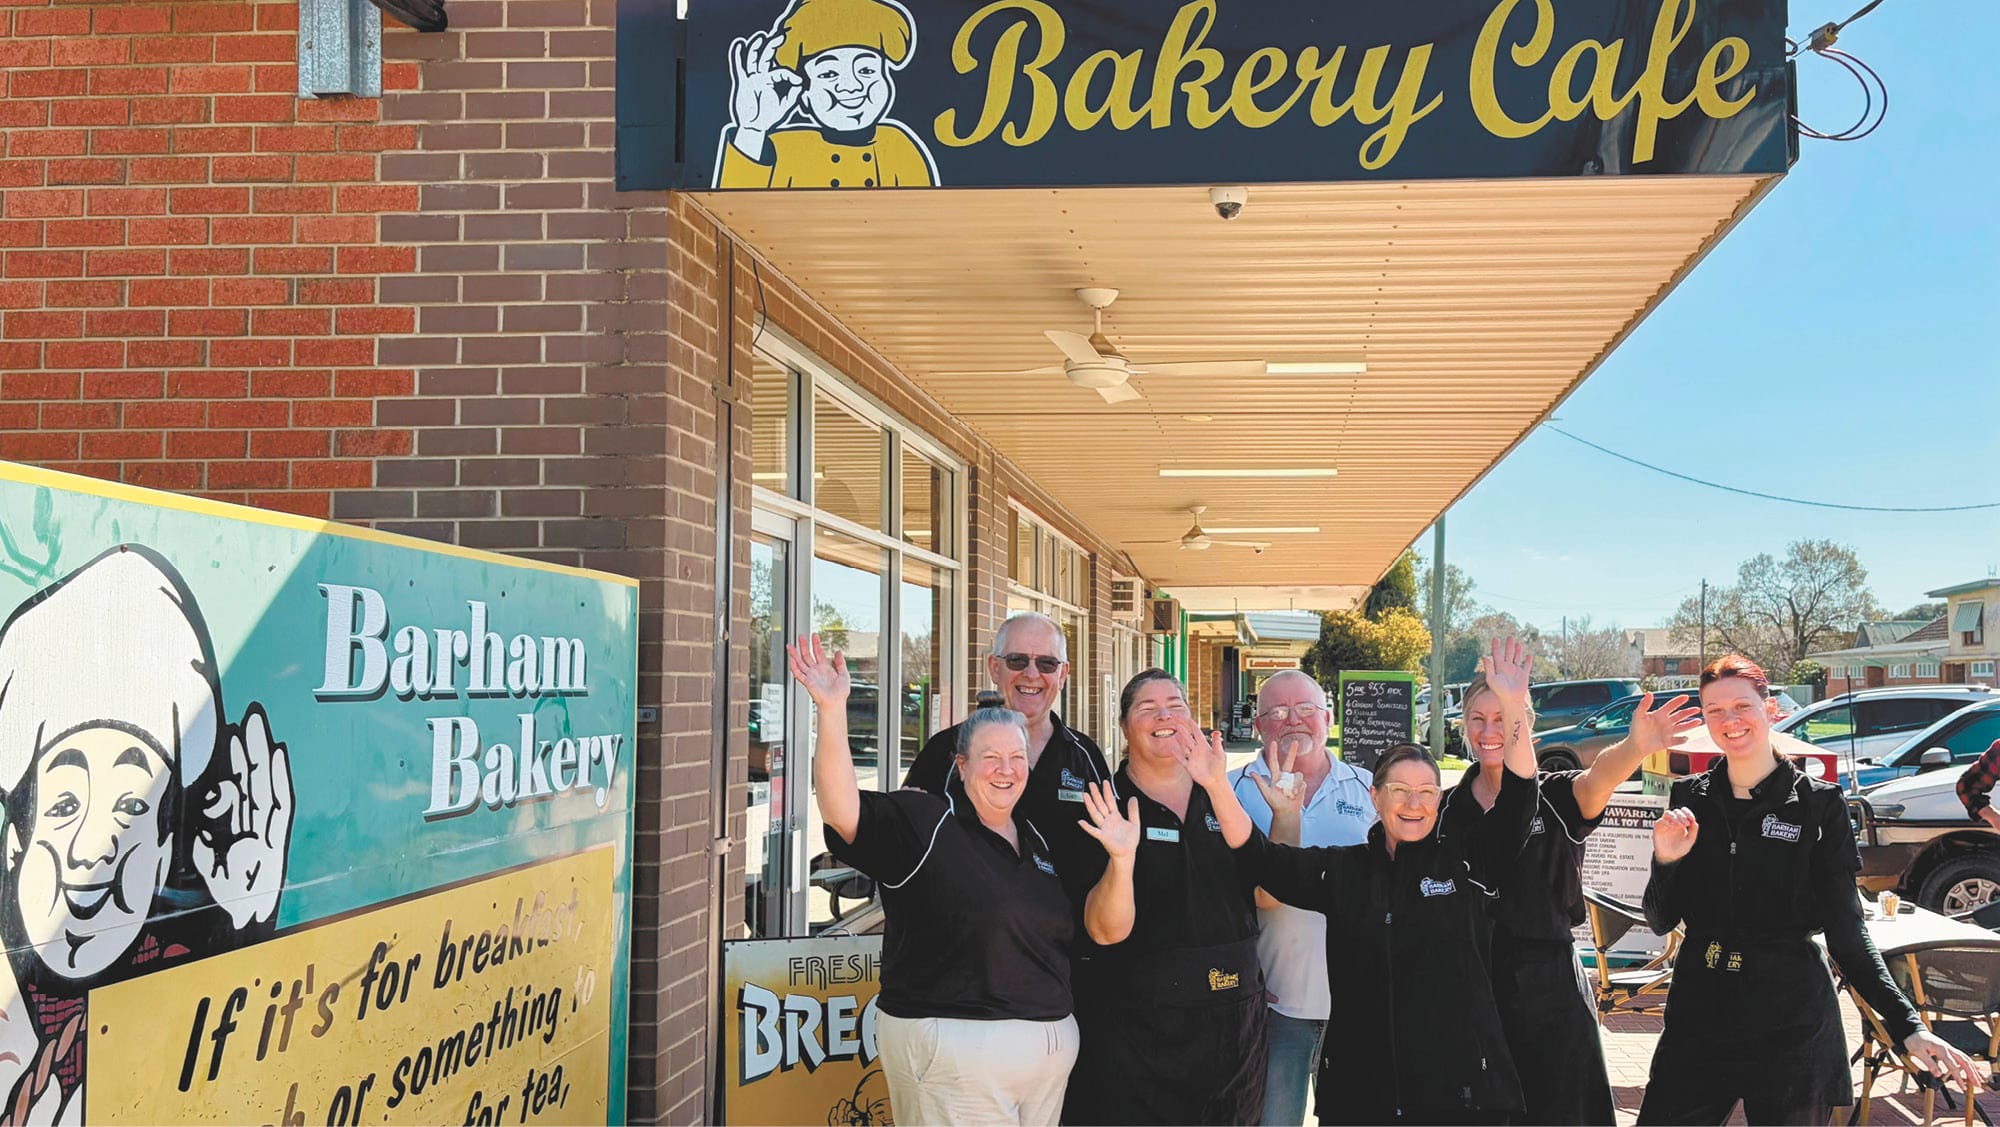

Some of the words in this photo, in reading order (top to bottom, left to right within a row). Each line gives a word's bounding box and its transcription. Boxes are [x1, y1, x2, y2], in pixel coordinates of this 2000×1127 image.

[933, 0, 1443, 170] Bakery
[1469, 0, 1756, 164] Cafe
[312, 583, 590, 703] Barham
[1346, 682, 1355, 697] 5
[1368, 681, 1386, 697] $55
[422, 712, 624, 823] Bakery
[1621, 818, 1639, 827] TOY
[1770, 830, 1797, 839] BAKERY
[178, 988, 248, 1092] If
[256, 964, 341, 1061] it's
[359, 941, 421, 1020] for
[433, 889, 584, 989] breakfast,
[386, 971, 562, 1108] something
[520, 1065, 570, 1124] tea,
